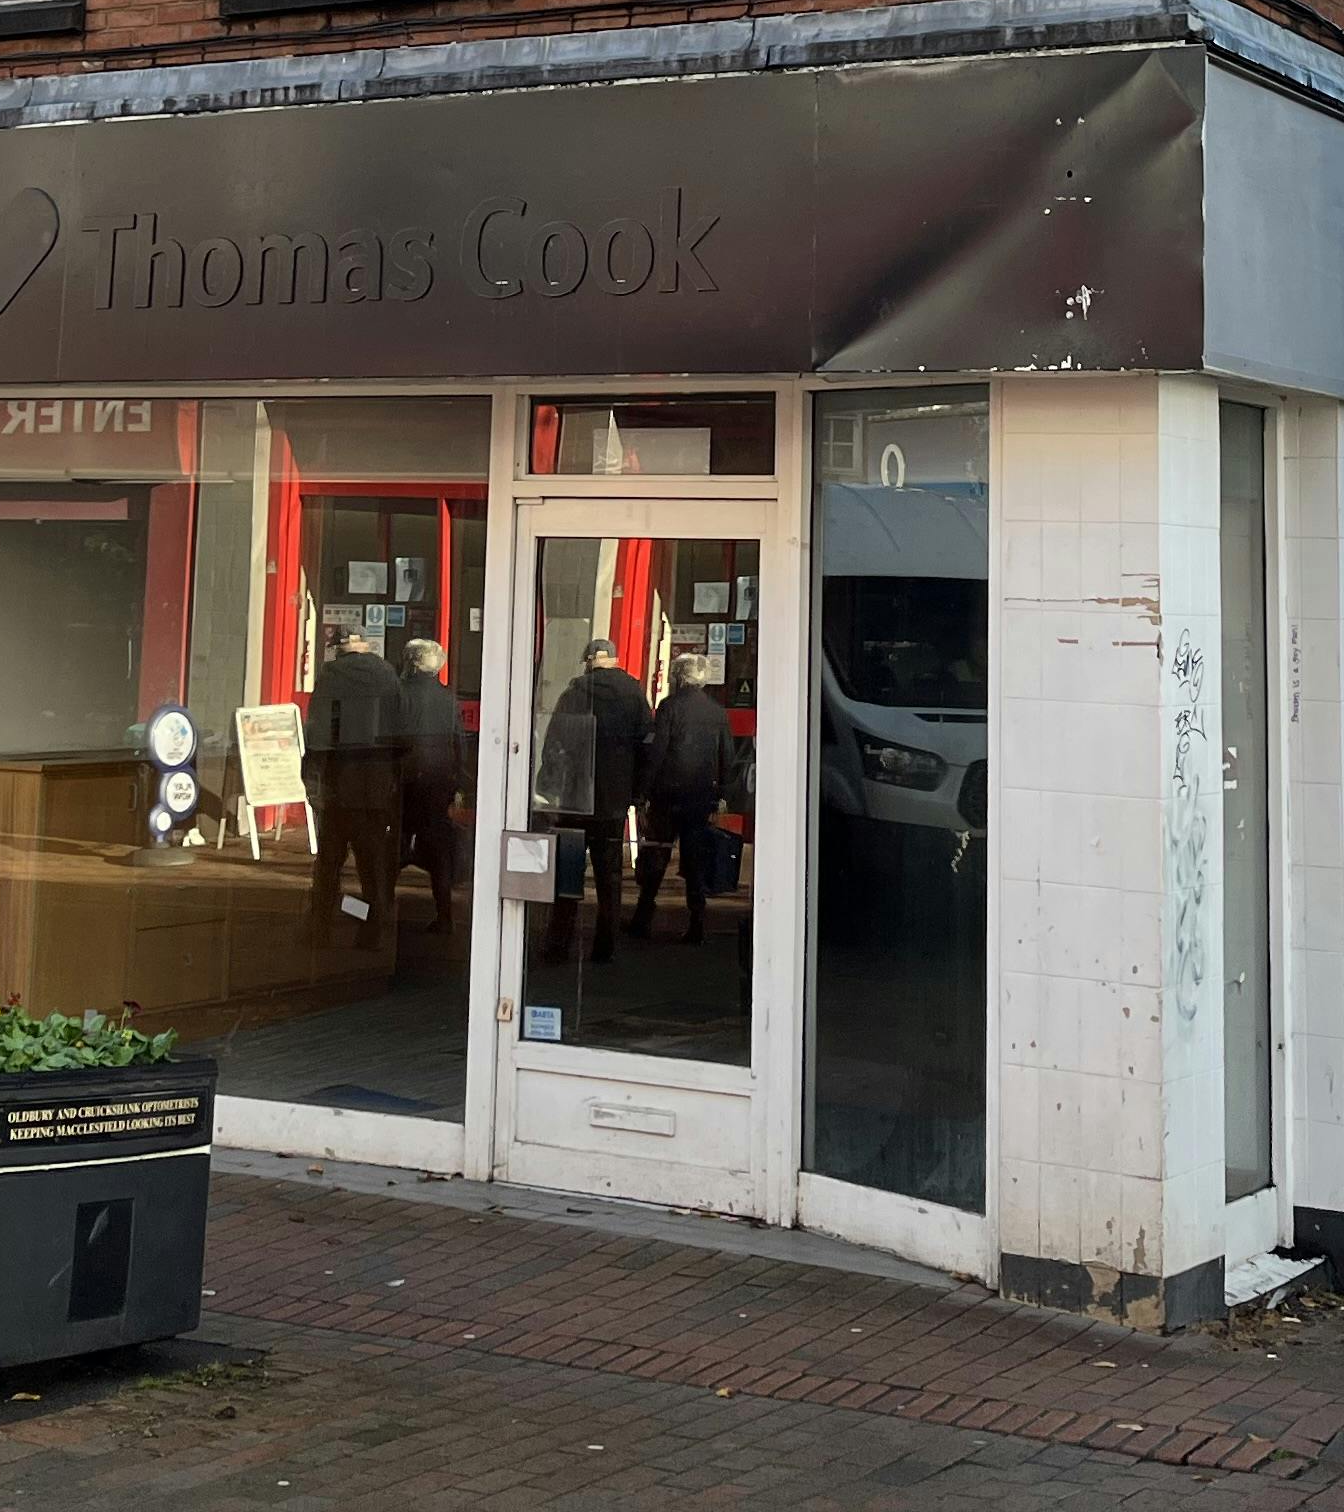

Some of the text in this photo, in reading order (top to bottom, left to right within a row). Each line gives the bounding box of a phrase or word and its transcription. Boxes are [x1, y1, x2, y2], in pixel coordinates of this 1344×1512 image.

[81, 186, 721, 310] Thomas Cook
[8, 1097, 199, 1124] OLDBURY AND CRUICKSHANK OPTOMETRISTS
[9, 1113, 196, 1141] KEEPING MACCLESFIELD LOOKING ITS BEST
